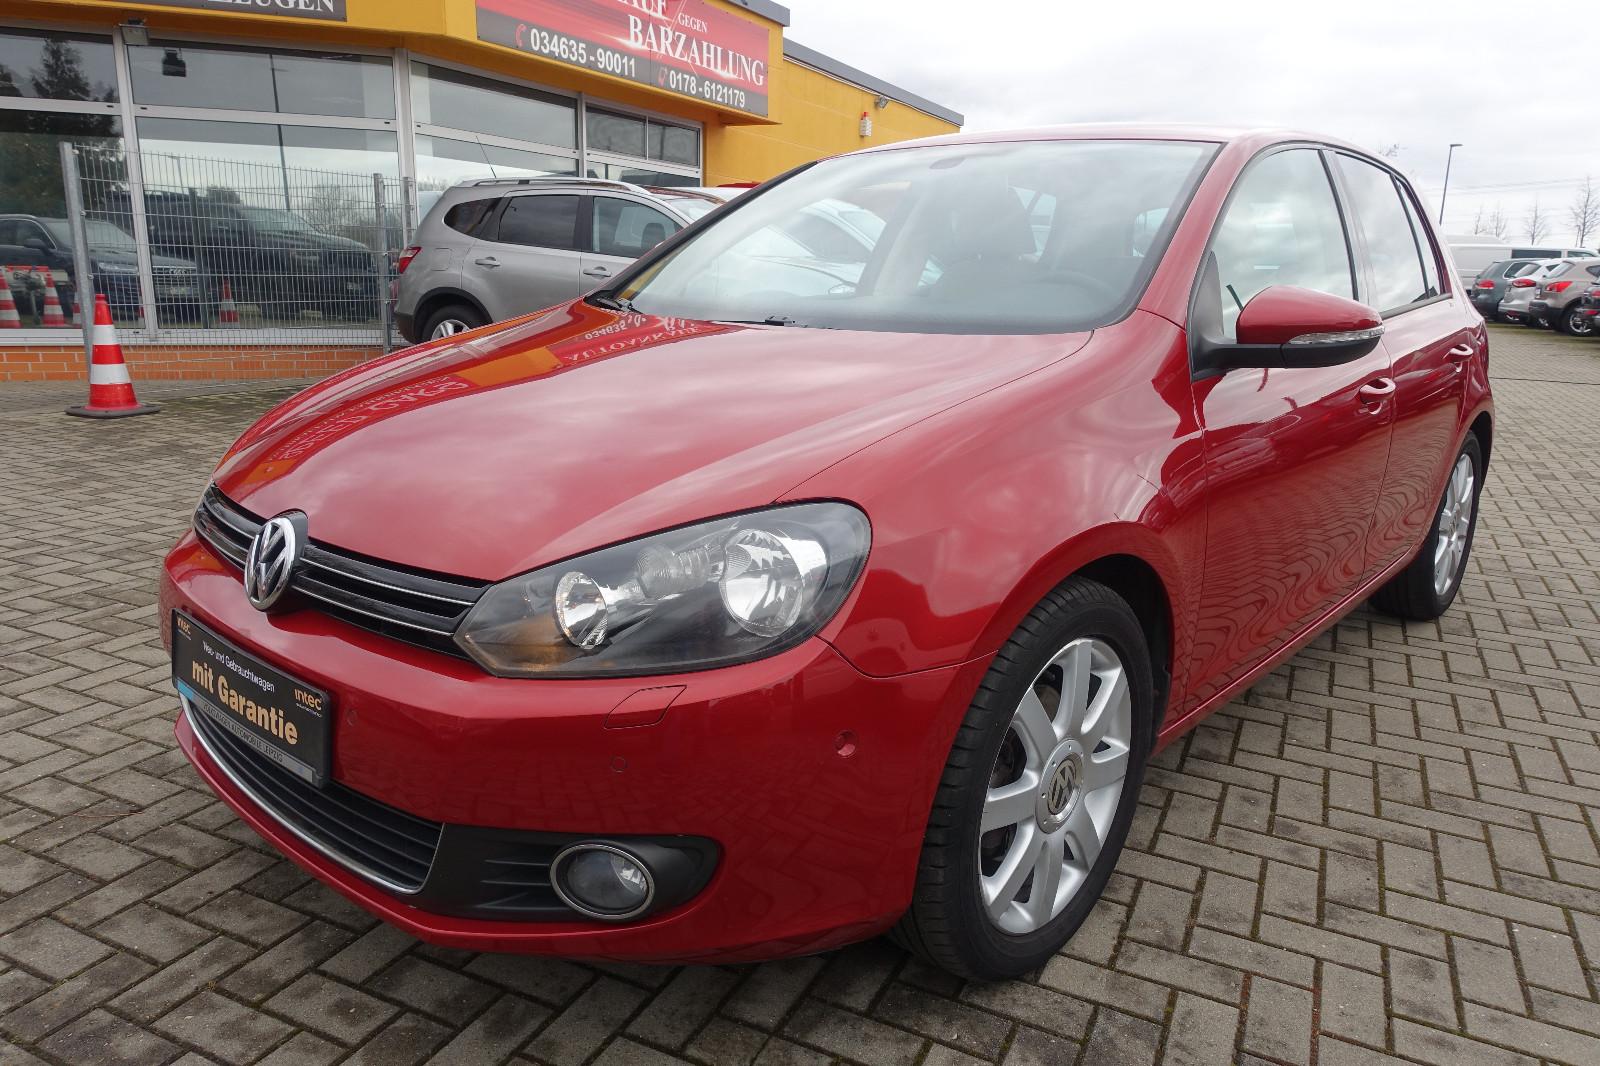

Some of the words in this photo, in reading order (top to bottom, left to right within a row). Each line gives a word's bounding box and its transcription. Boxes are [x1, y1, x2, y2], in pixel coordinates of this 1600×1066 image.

[628, 14, 764, 86] BARZAHLUNG
[678, 13, 708, 33] GEGEN
[192, 660, 214, 694] mit
[217, 674, 298, 745] Garantie
